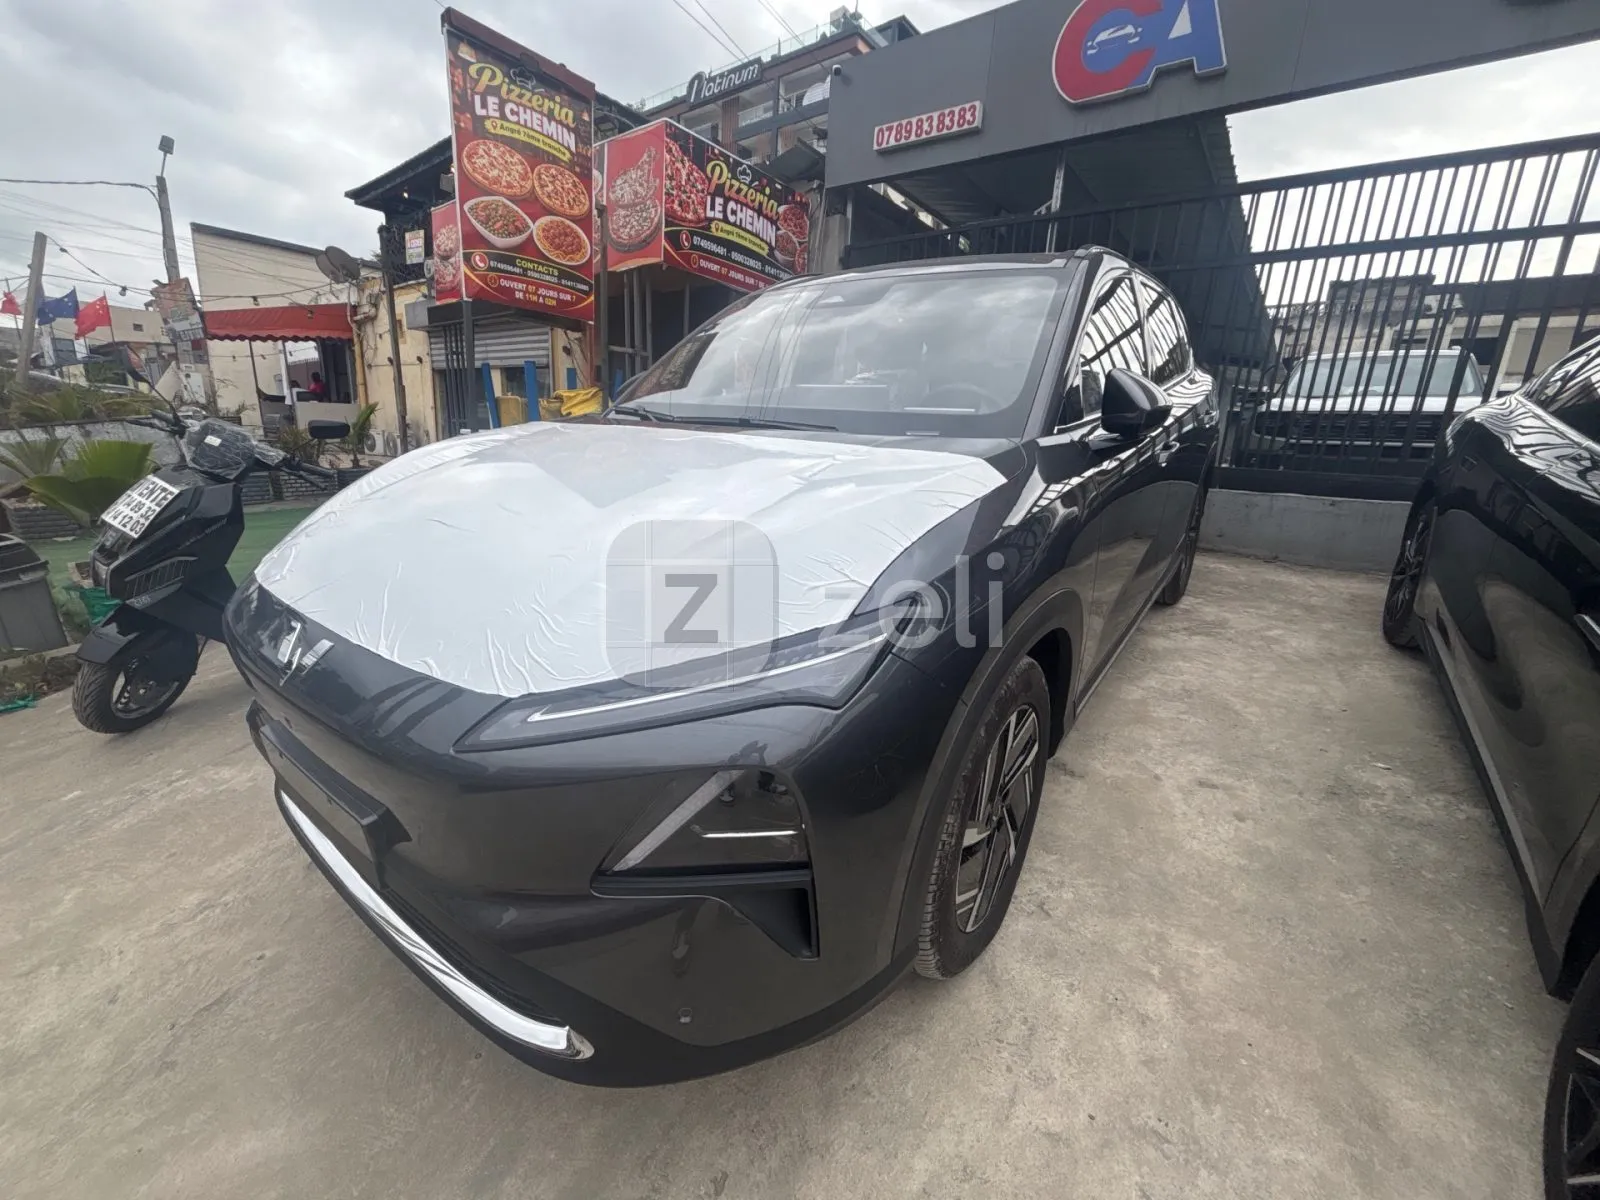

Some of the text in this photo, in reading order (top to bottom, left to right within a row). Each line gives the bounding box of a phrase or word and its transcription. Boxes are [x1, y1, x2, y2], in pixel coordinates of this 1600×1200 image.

[468, 62, 577, 129] Pizzeria
[690, 64, 759, 103] Platinum
[474, 94, 576, 154] LE CHEMIN
[706, 160, 779, 220] Pizzeria
[706, 195, 776, 248] LE CHEMIN
[515, 258, 559, 276] CONTACTS
[699, 259, 720, 273] OUVERT
[499, 278, 527, 291] OUVERT
[537, 287, 558, 297] JOURS
[558, 292, 571, 301] SUR
[514, 291, 524, 300] DE
